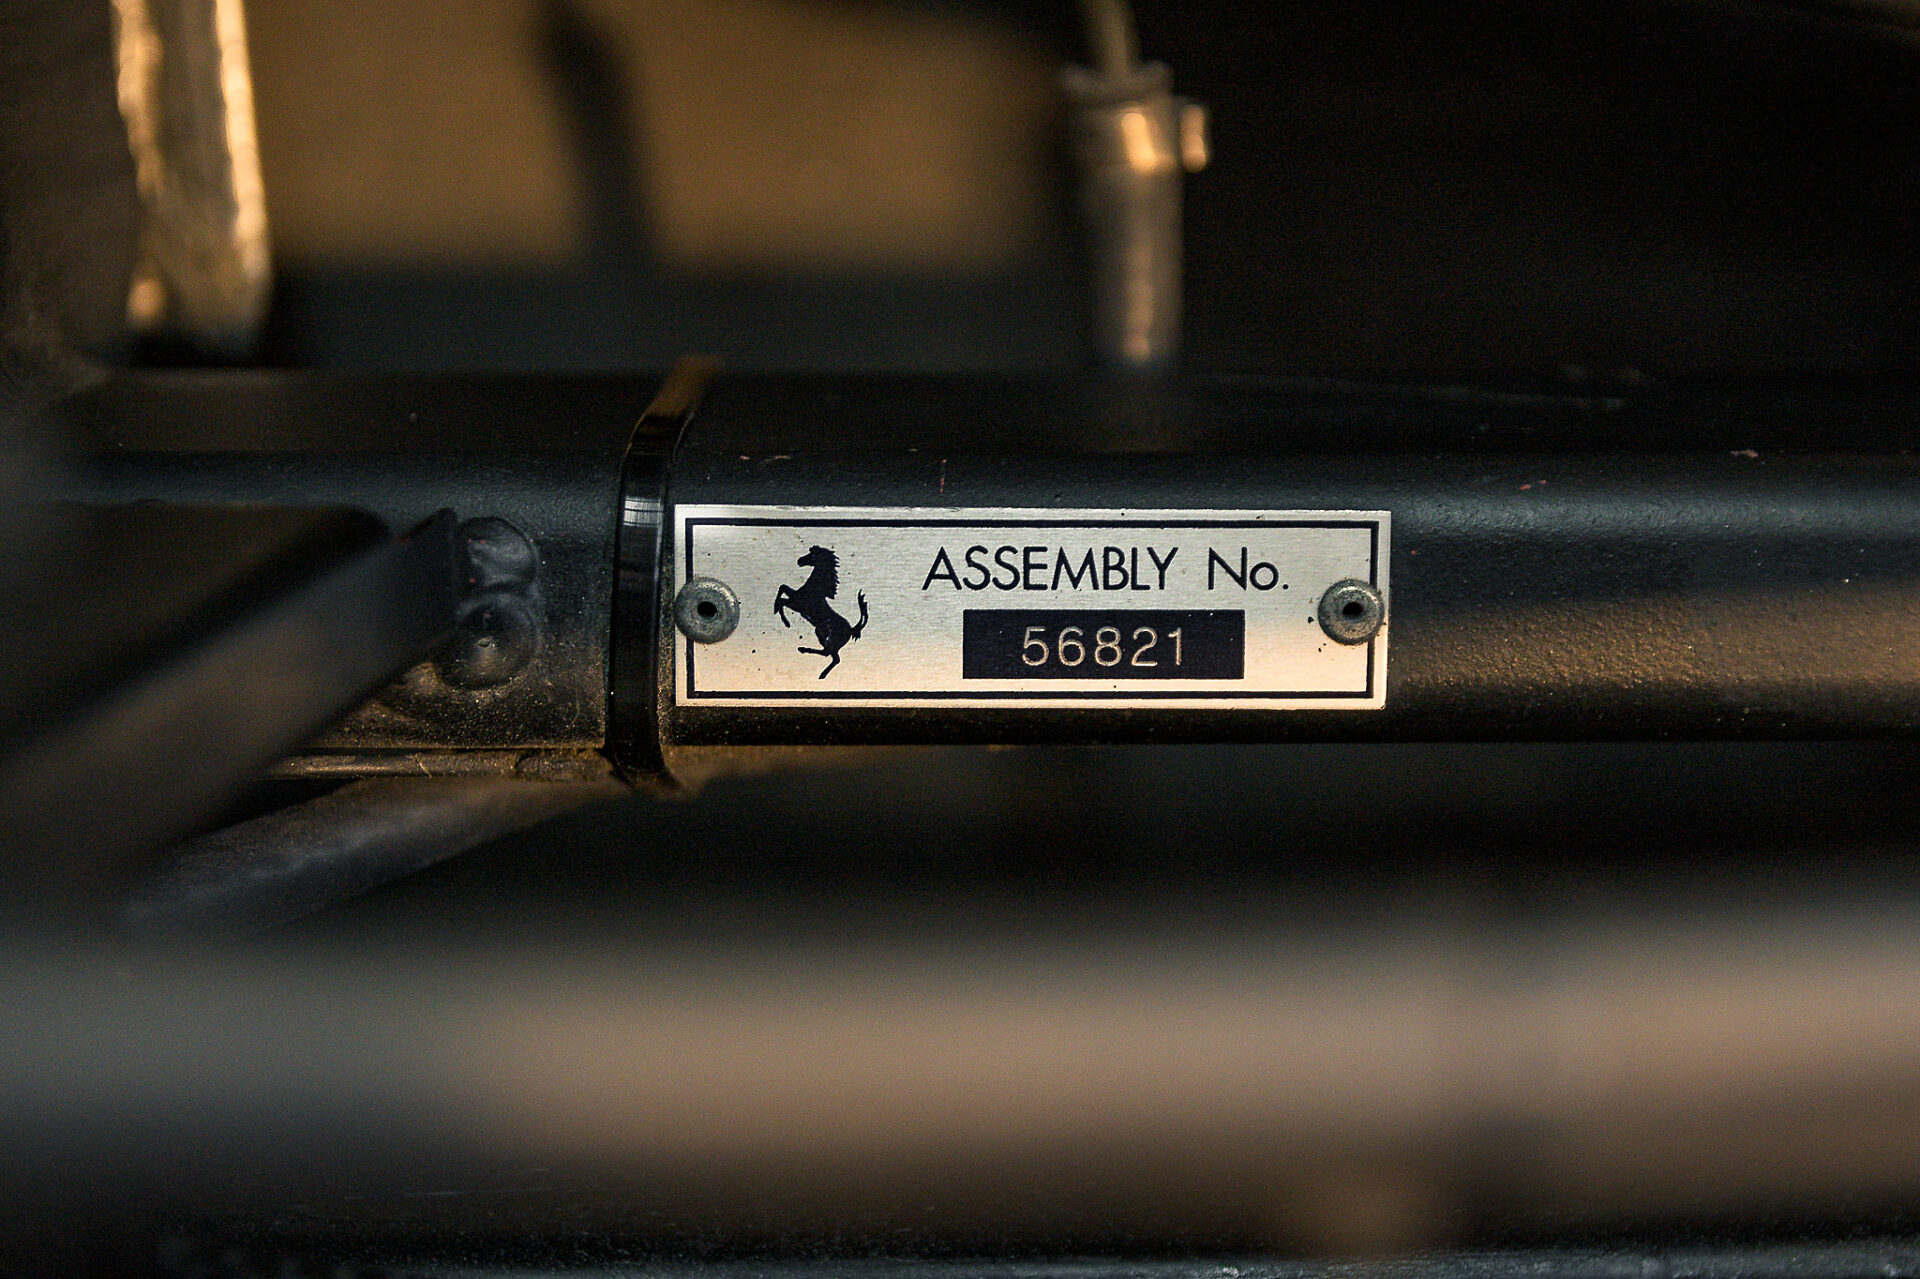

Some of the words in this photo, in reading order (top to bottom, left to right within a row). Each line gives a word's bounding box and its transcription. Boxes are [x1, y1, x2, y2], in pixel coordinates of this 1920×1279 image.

[921, 545, 1179, 591] ASSEMBLY
[1207, 546, 1290, 591] No.
[1021, 626, 1183, 667] 56821
